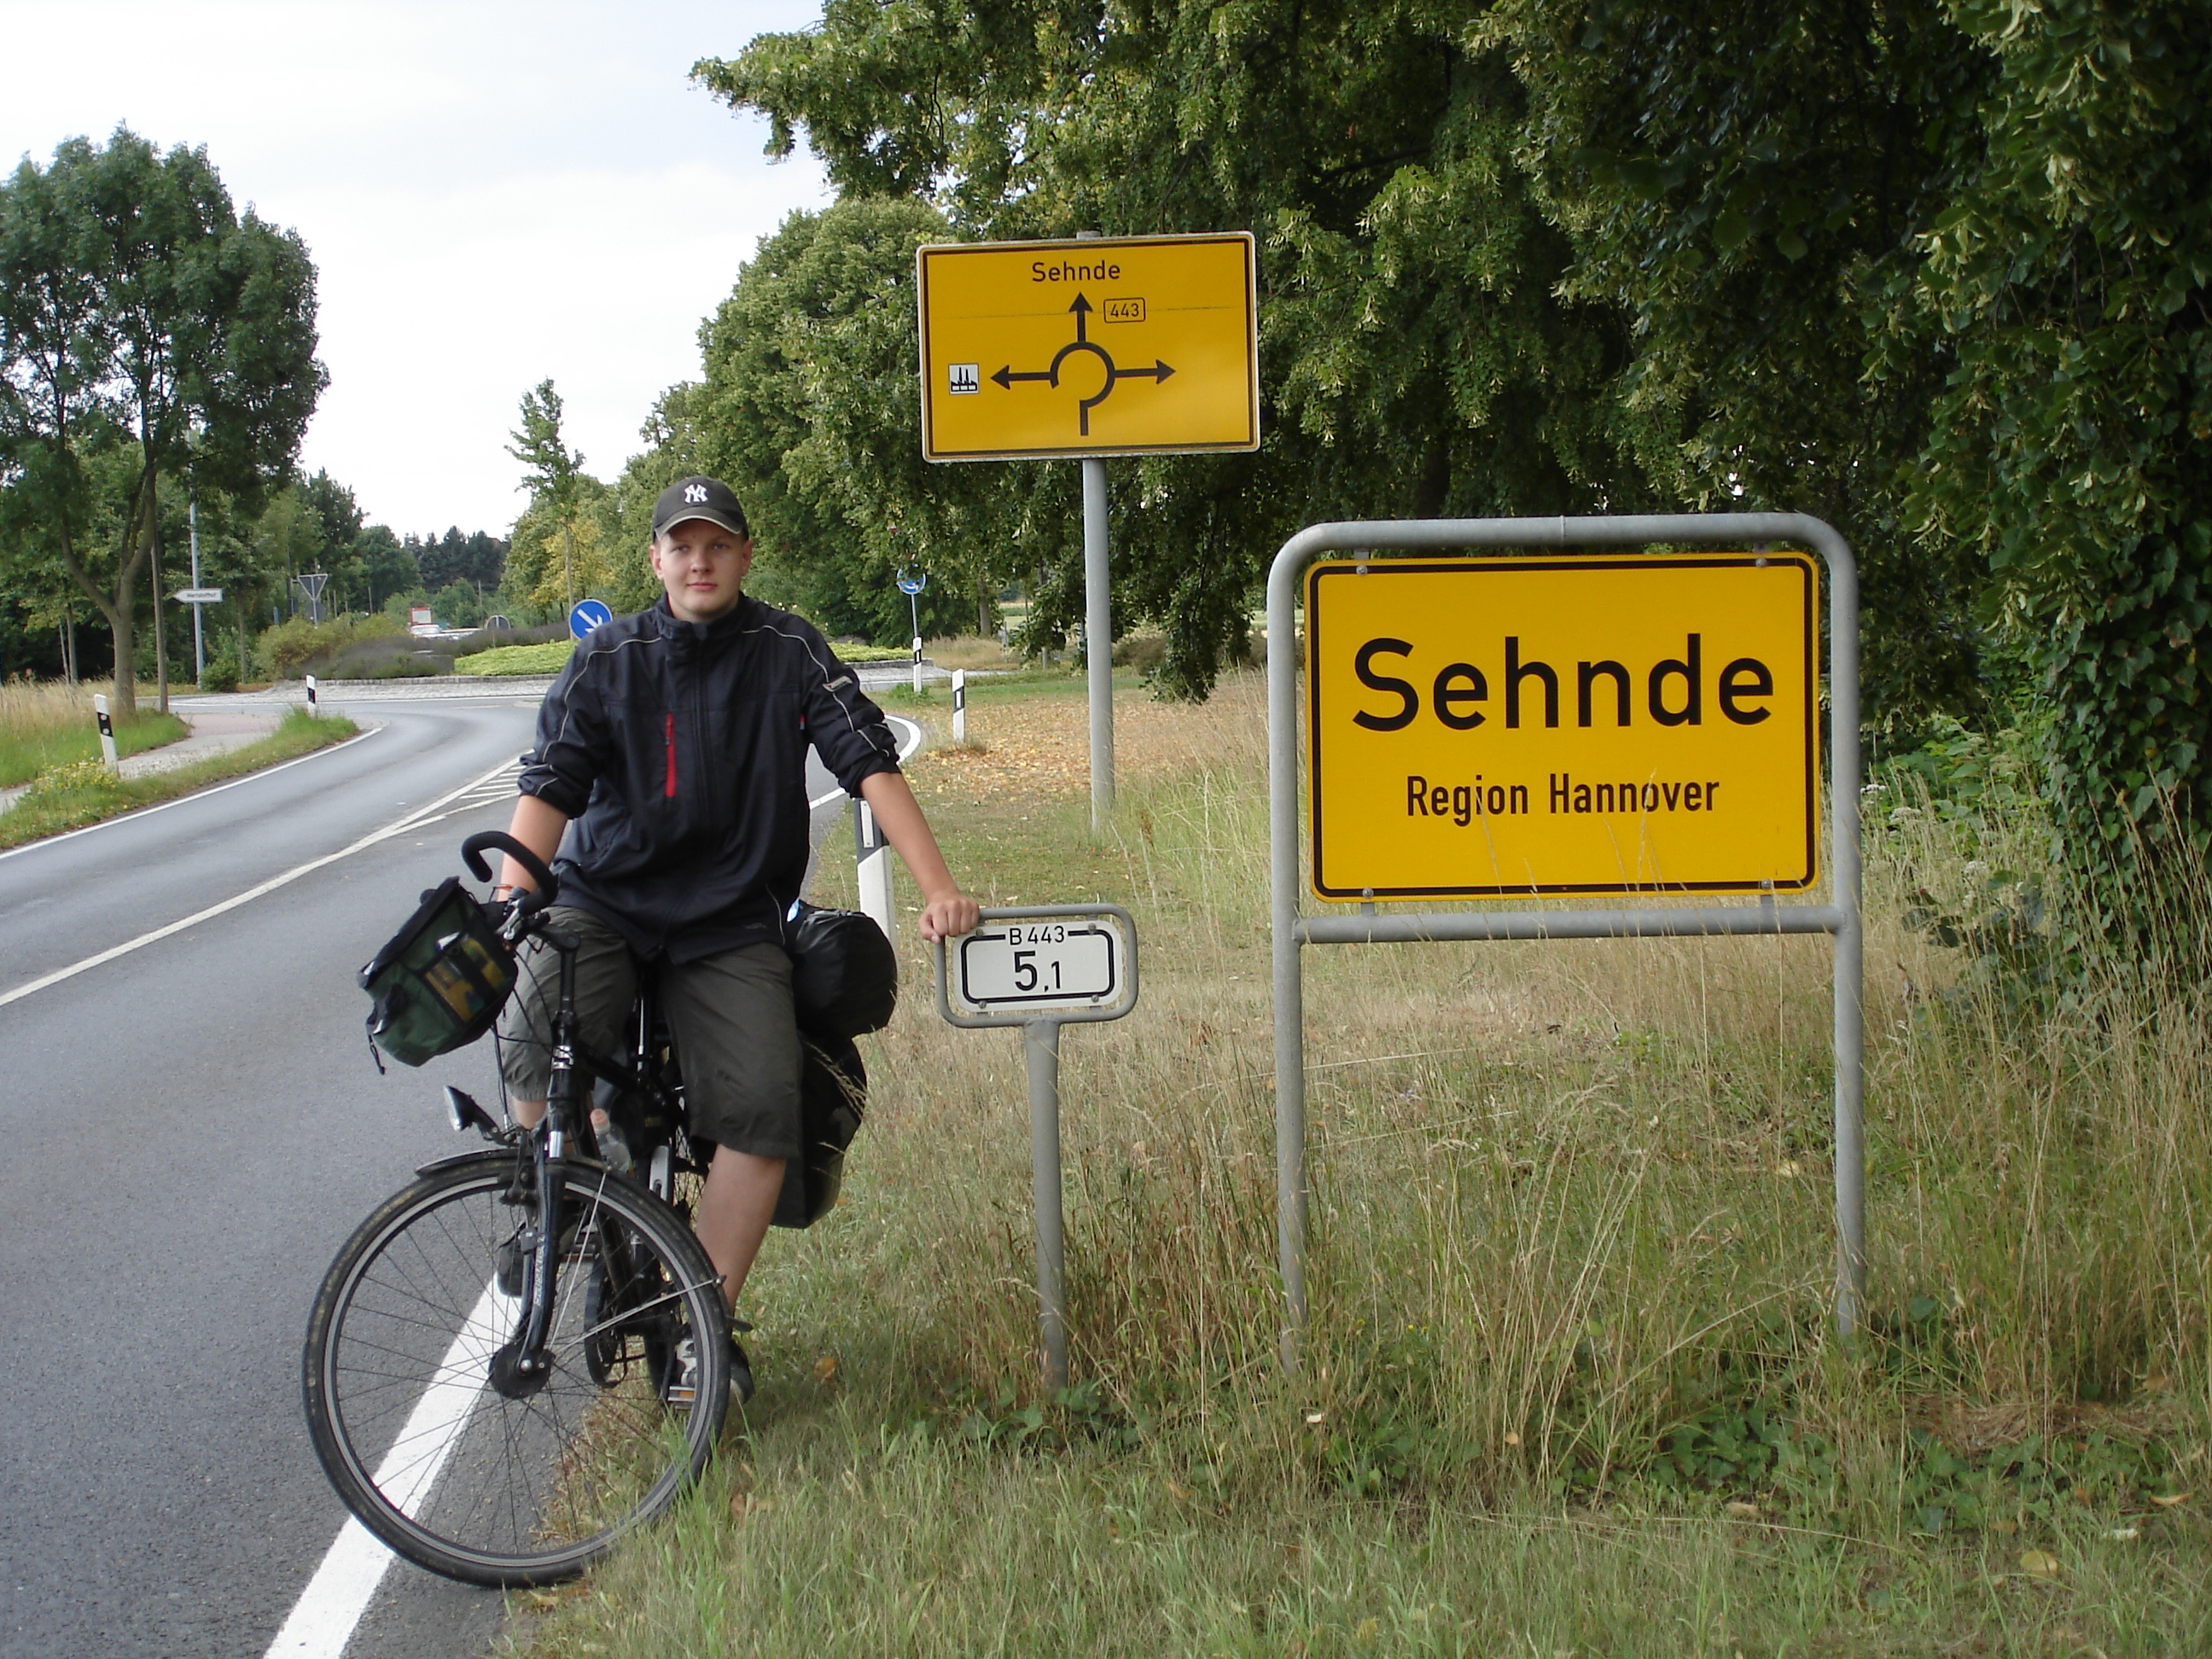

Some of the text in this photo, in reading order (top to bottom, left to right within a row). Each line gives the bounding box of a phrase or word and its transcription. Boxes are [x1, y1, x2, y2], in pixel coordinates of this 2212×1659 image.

[1031, 259, 1121, 282] Sehnde
[1109, 303, 1140, 318] 443
[684, 483, 708, 504] NY
[1352, 632, 1774, 732] Sehnde
[1406, 773, 1720, 827] Region Hannover
[1014, 950, 1062, 992] 5,1
